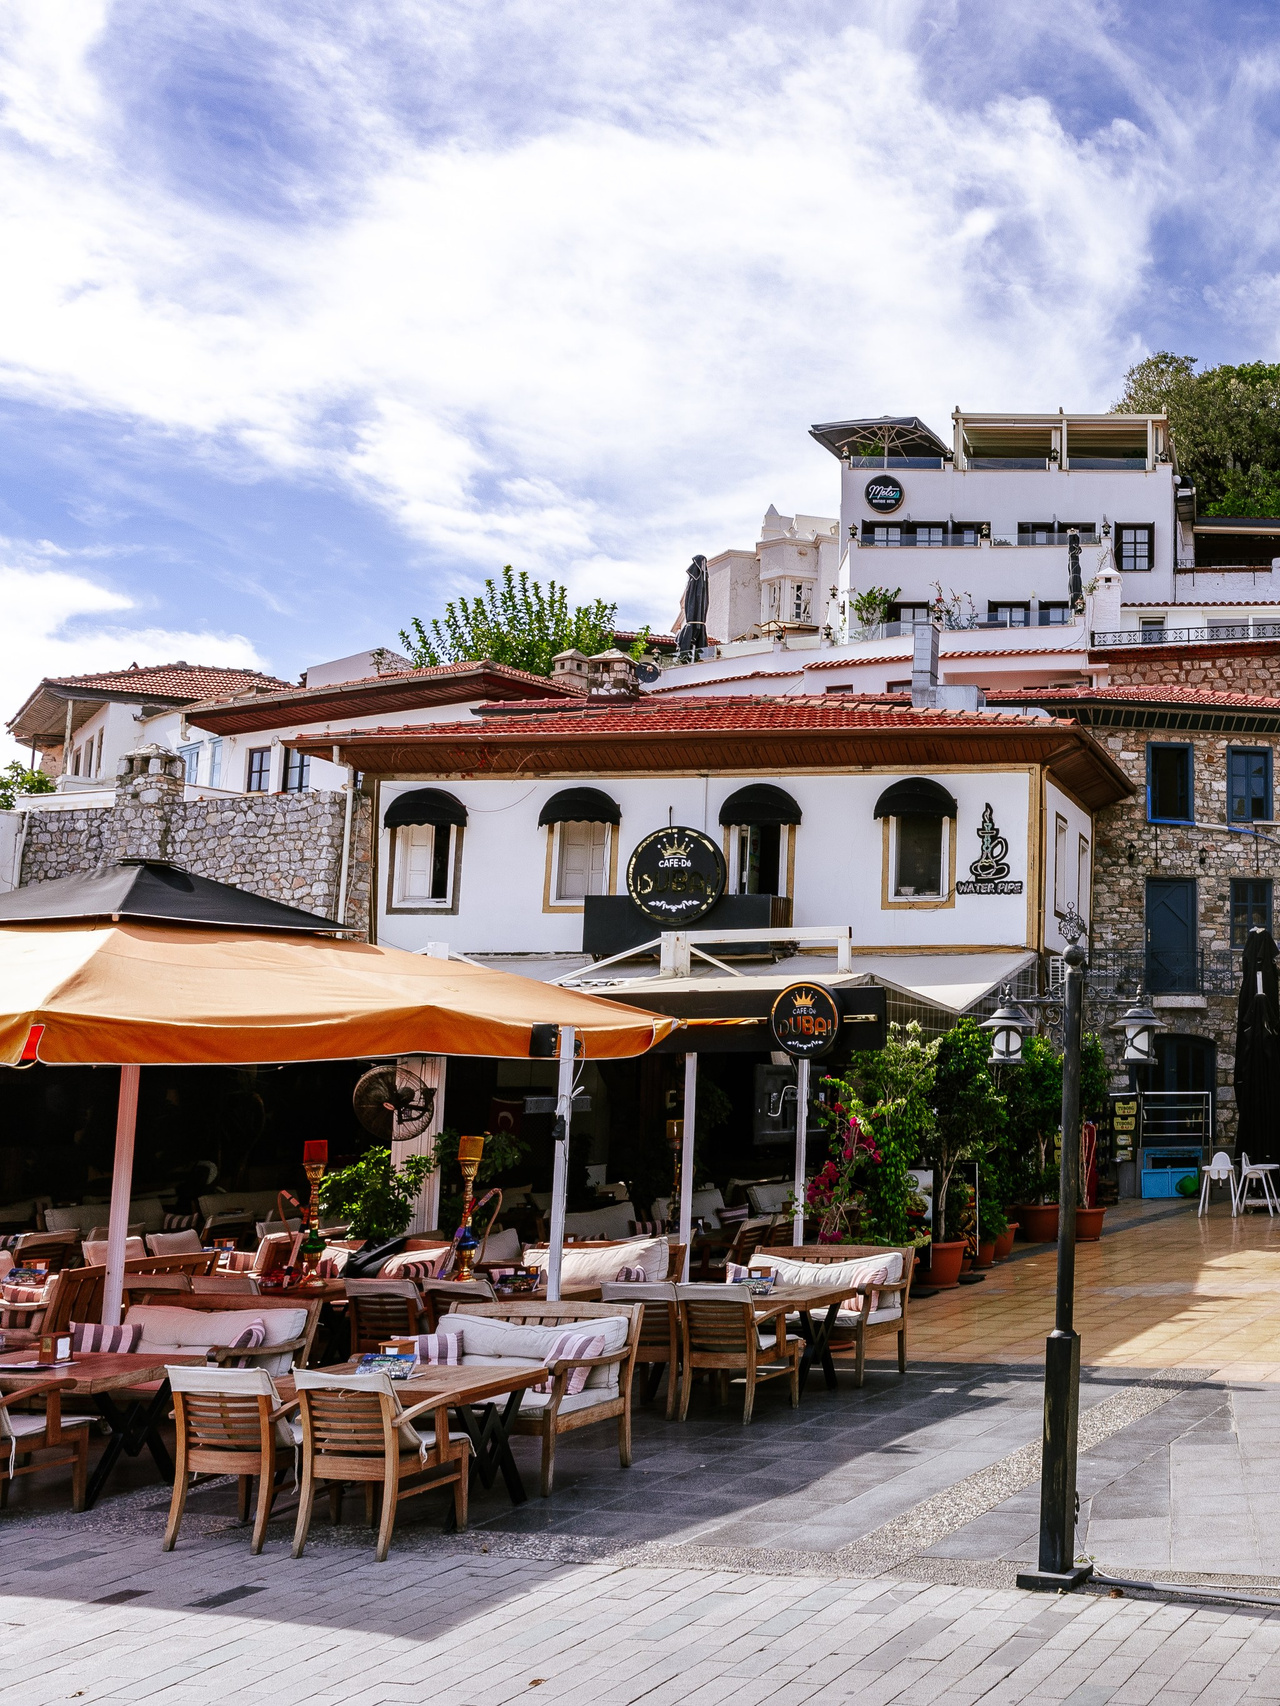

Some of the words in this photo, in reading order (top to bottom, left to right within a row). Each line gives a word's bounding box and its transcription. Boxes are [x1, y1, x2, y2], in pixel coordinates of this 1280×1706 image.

[637, 869, 712, 894] DUBAI
[958, 882, 995, 893] WATER
[997, 882, 1021, 893] PIPE
[777, 1015, 832, 1037] DUBAI
